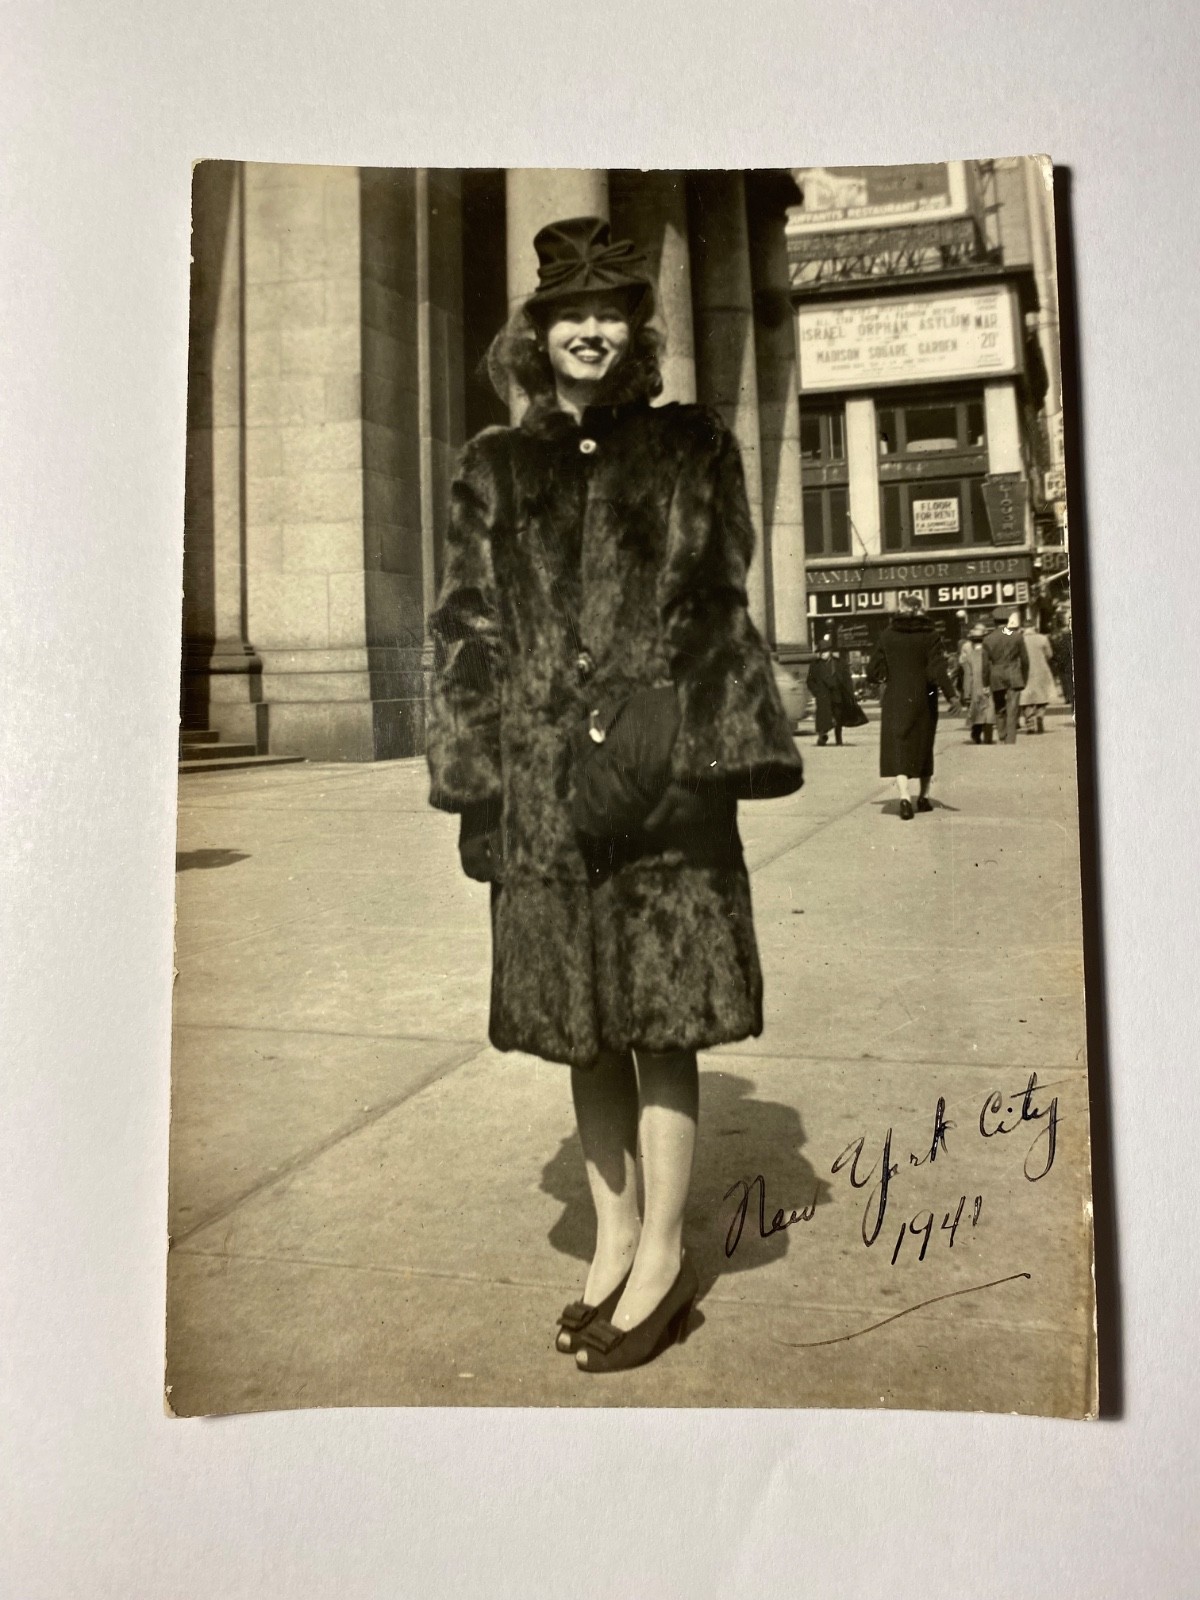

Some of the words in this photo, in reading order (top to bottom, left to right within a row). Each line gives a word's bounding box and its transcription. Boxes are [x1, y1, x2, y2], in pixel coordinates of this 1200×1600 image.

[802, 326, 846, 341] ISRAEL
[858, 319, 909, 336] ORPHAN
[919, 313, 970, 331] ASYLUM
[975, 313, 998, 329] MAR
[817, 348, 860, 363] MADISON
[868, 343, 907, 359] SQUARE
[918, 338, 958, 354] GARDEN
[916, 511, 931, 521] FOR
[934, 510, 956, 520] RENT
[920, 501, 952, 511] FLOOR
[879, 563, 949, 581] LIQUOR
[966, 559, 1019, 575] SHOP
[938, 584, 993, 602] SHOP
[723, 1174, 823, 1259] New
[831, 1096, 957, 1248] York
[979, 1071, 1066, 1182] City
[891, 1195, 983, 1266] 1941
